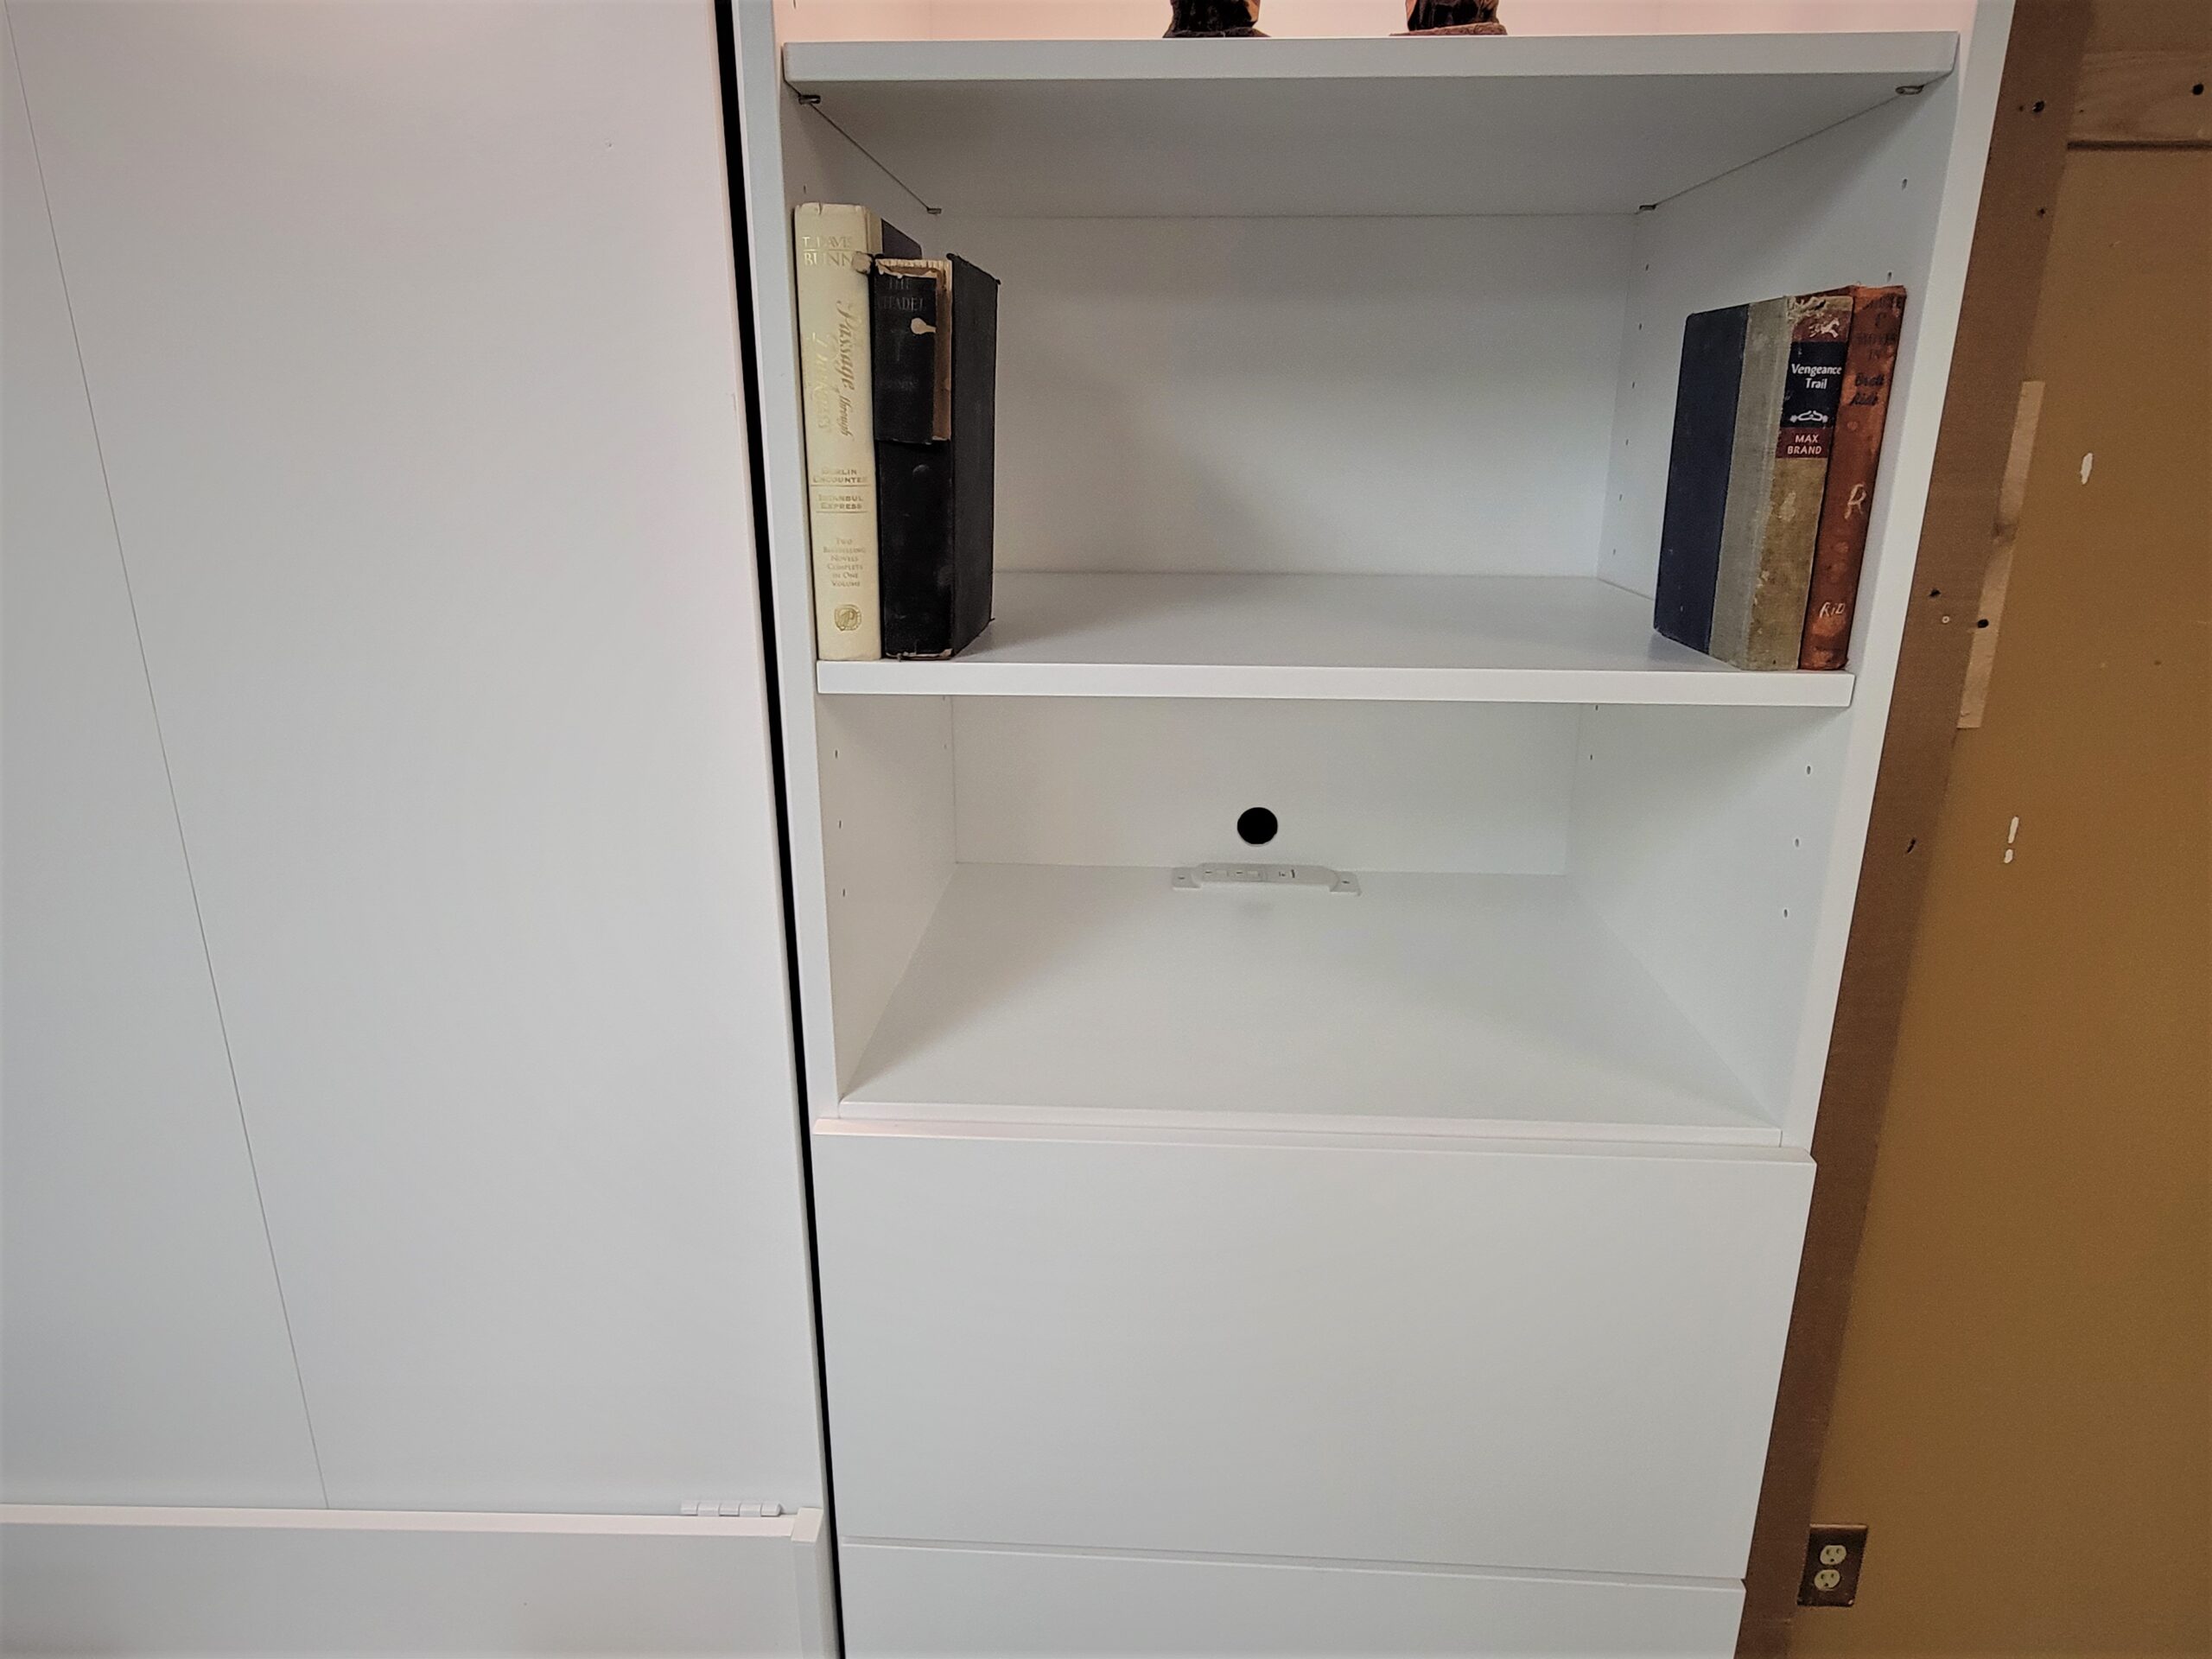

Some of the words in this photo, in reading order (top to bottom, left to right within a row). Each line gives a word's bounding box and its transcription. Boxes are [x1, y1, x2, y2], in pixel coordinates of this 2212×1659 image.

[834, 299, 861, 391] Passage
[1790, 363, 1842, 377] Vengeance
[1804, 378, 1827, 390] Trail
[1795, 434, 1819, 443] MAX
[1787, 445, 1822, 455] BRAND
